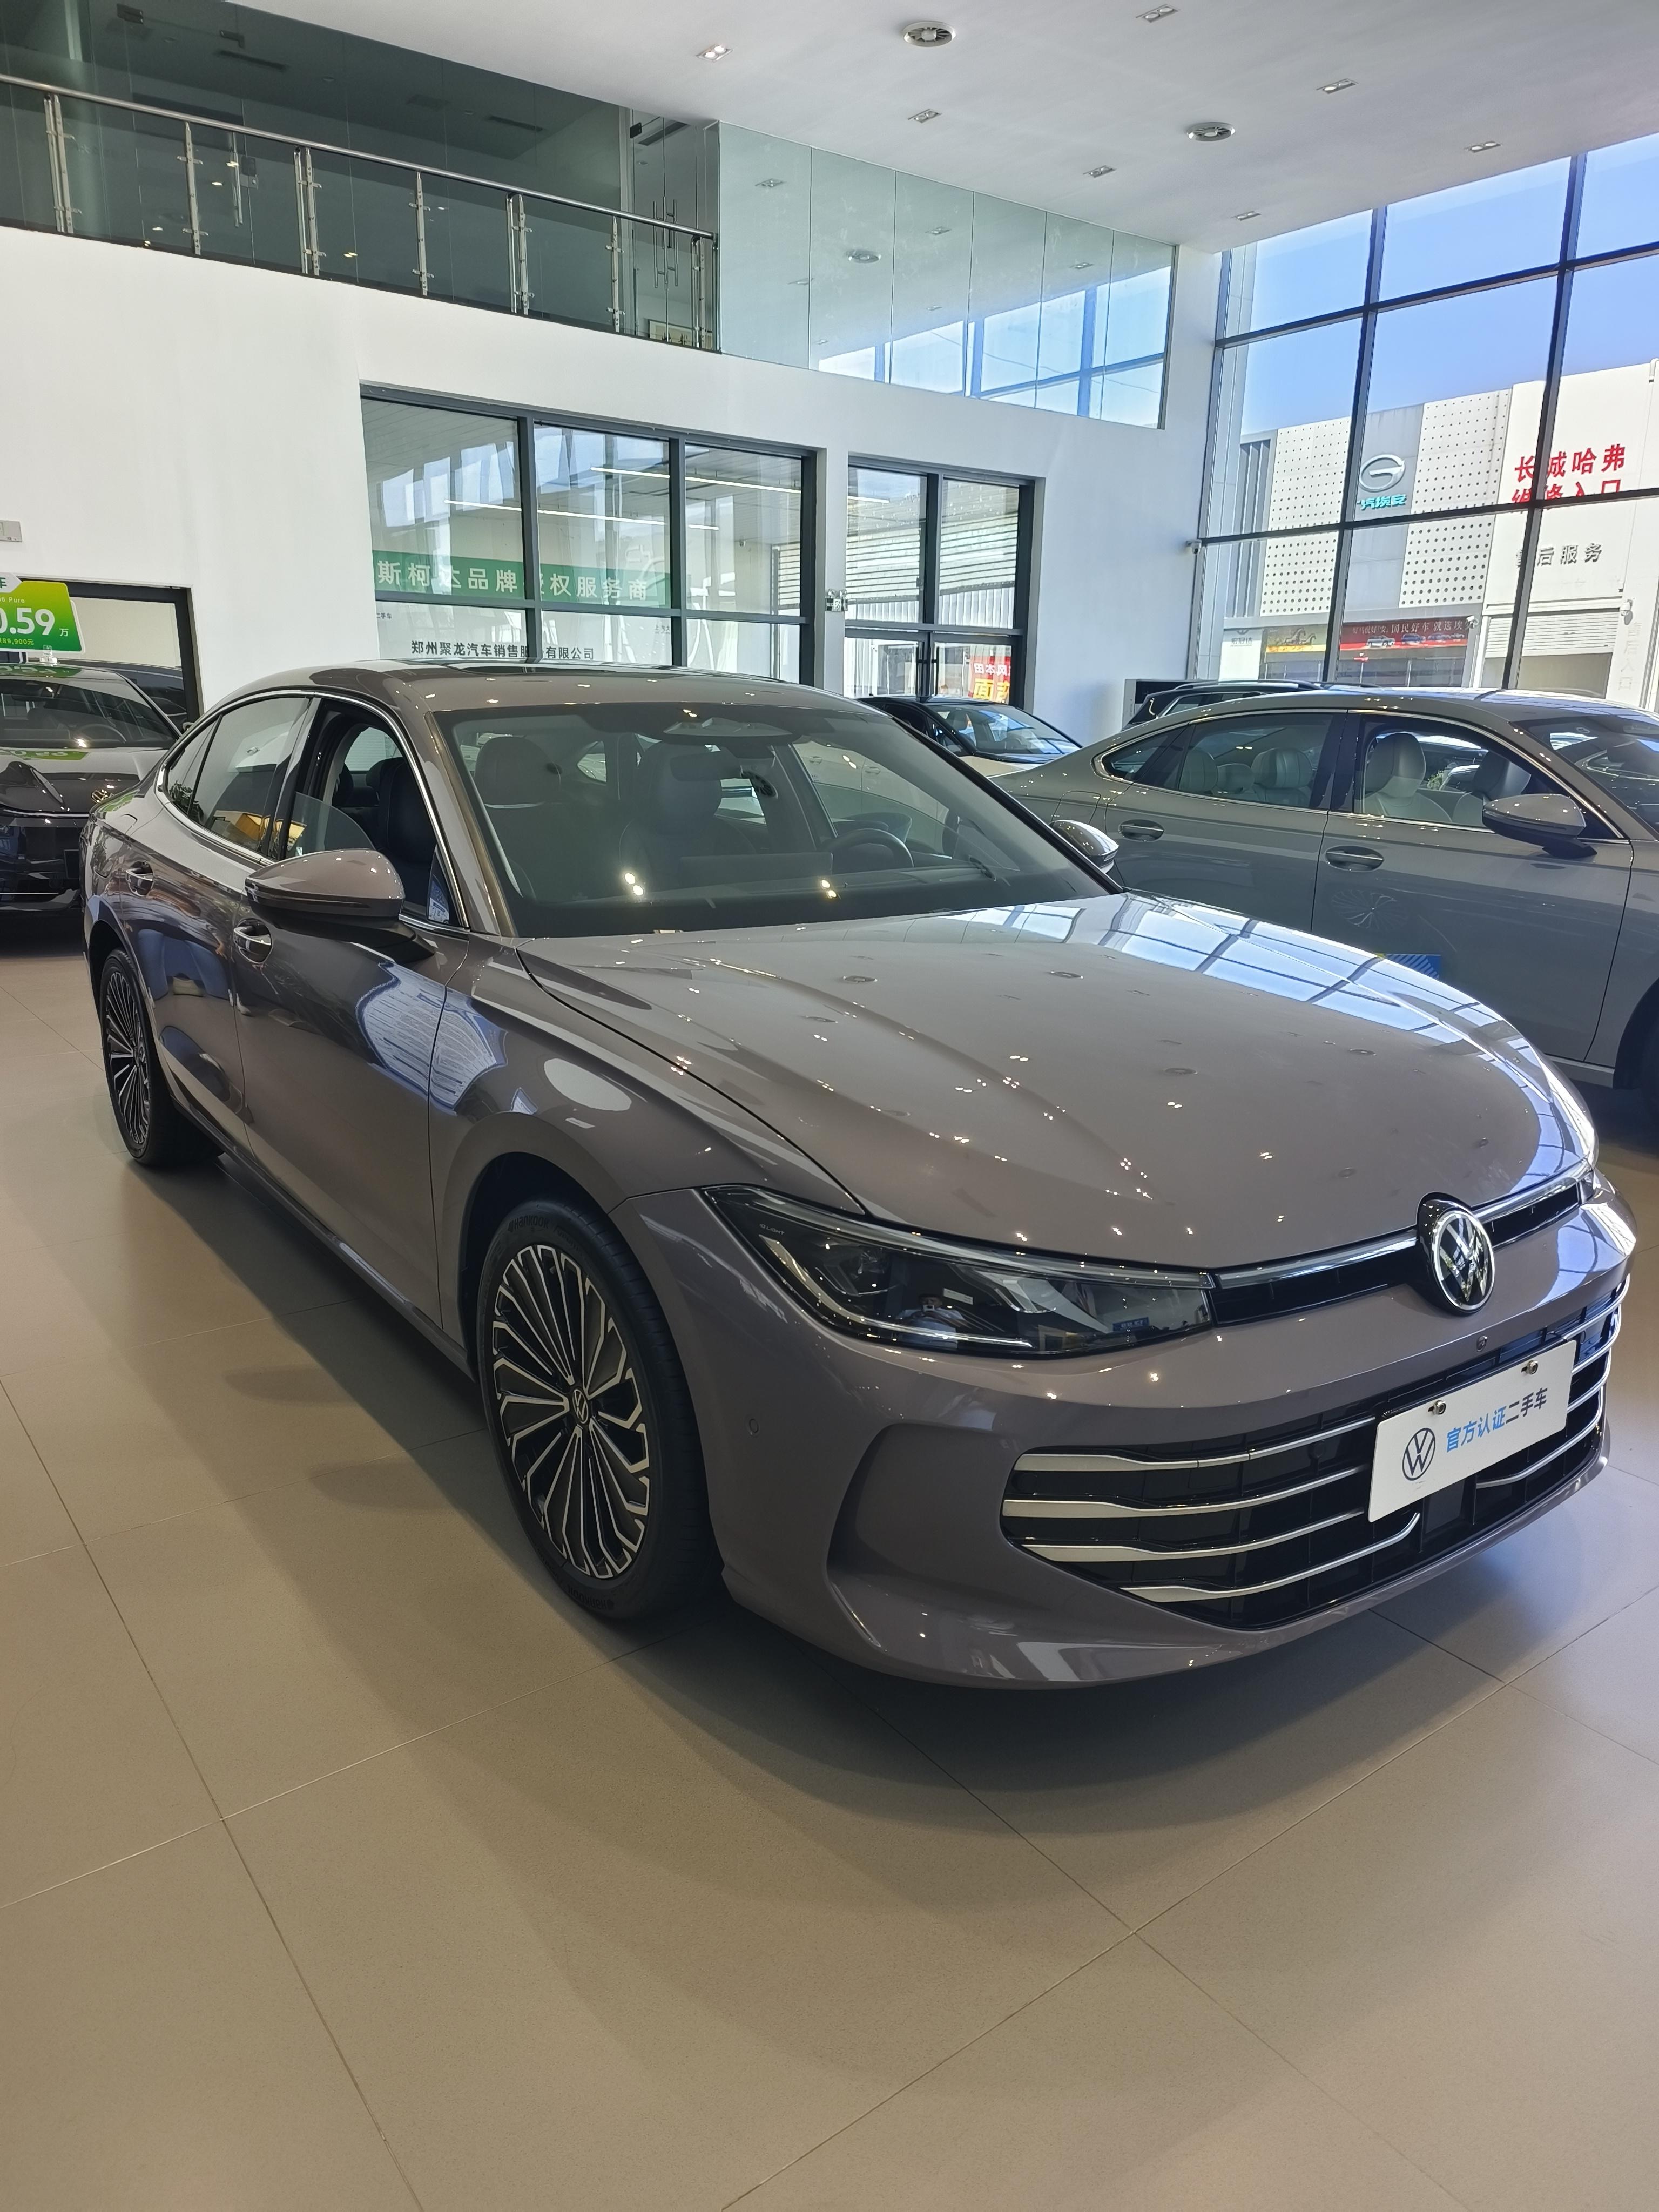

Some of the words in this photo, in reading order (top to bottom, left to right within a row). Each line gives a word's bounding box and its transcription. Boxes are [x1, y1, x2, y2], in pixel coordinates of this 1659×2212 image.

[1357, 494, 1407, 511] 汽埃安
[59, 628, 69, 637] 万
[411, 640, 594, 660] 郑州聚龙汽车销售服有限公司
[1446, 1387, 1548, 1453] 官方认证二手车
